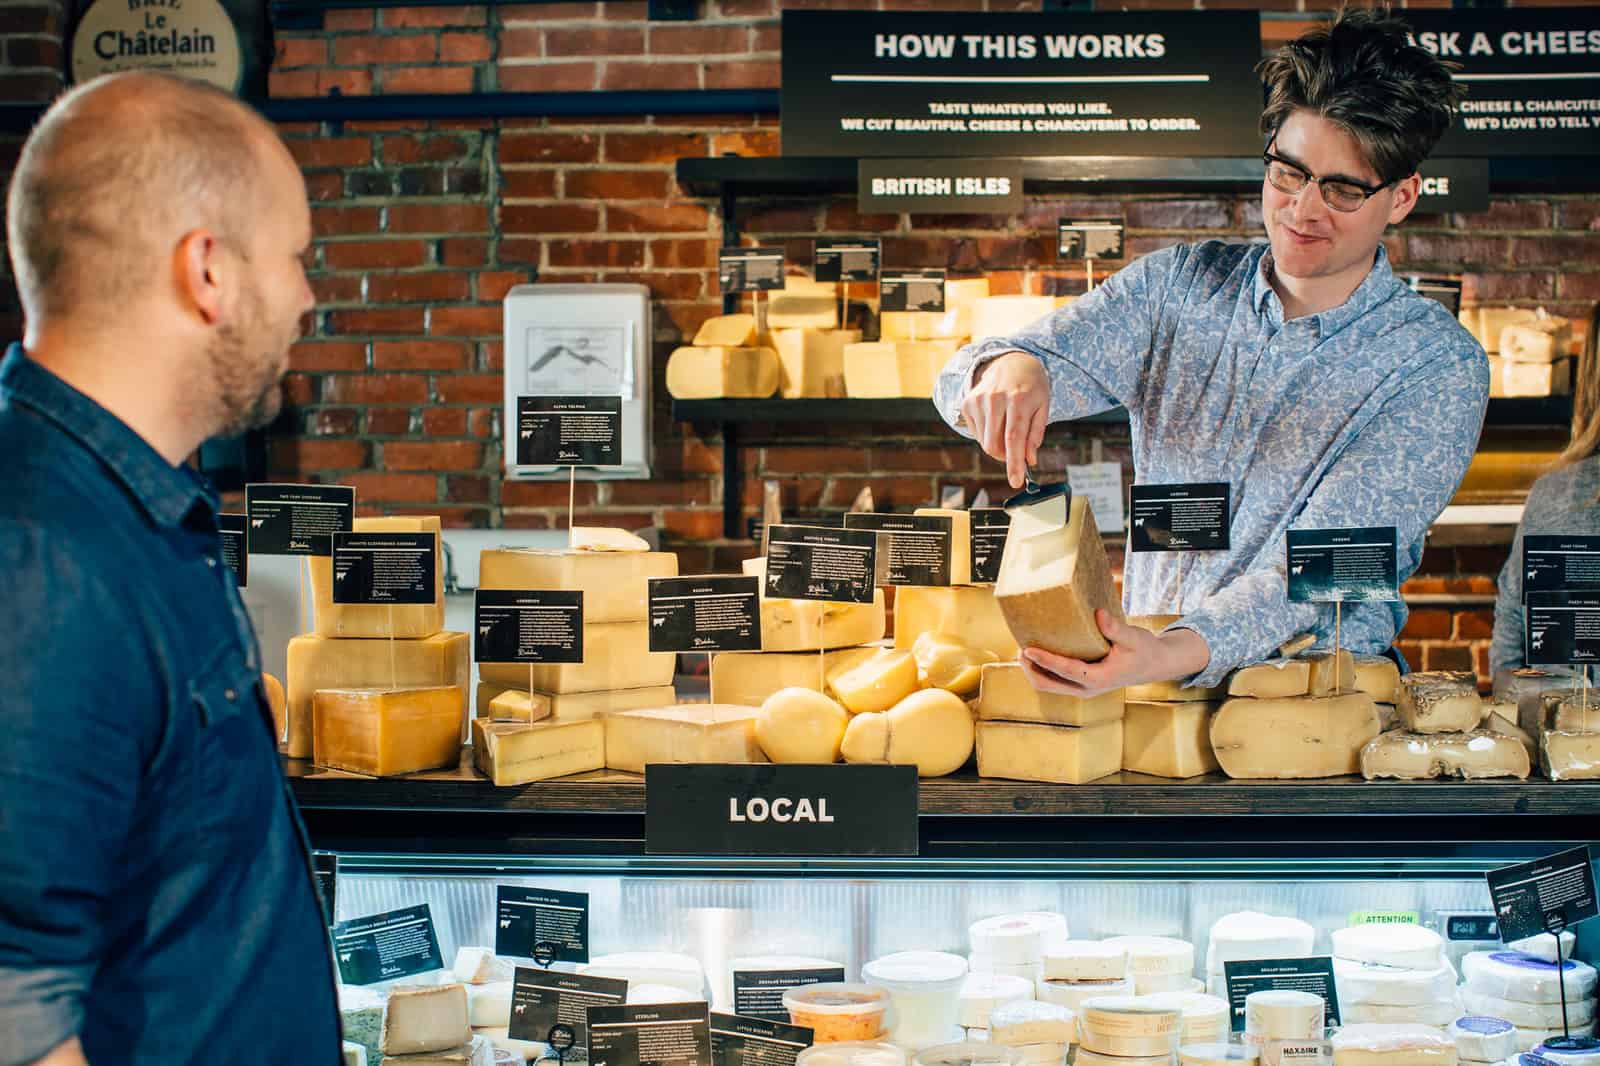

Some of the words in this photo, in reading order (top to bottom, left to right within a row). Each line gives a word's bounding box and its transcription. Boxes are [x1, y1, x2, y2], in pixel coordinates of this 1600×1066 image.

[144, 12, 167, 29] Le
[94, 28, 215, 60] Châtelain
[875, 33, 956, 58] HOW
[962, 34, 1038, 58] THIS
[1044, 33, 1166, 58] WORKS
[1469, 31, 1494, 56] A
[928, 102, 970, 115] TASTE
[970, 102, 1045, 115] WHATEVER
[1047, 102, 1076, 115] YOU
[1077, 102, 1113, 115] LIKE.
[1460, 100, 1511, 112] CHEESE
[1513, 100, 1524, 112] &
[841, 118, 865, 131] WE
[866, 118, 894, 131] CUT
[895, 118, 967, 131] BEAUTIFUL
[968, 118, 1021, 132] CHEESE
[1022, 119, 1034, 132] &
[1035, 118, 1129, 132] CHARCUTERIE
[1129, 118, 1149, 131] TO
[1149, 117, 1201, 131] ORDER.
[1463, 116, 1500, 129] WE'D
[1502, 116, 1537, 129] LOVE
[1538, 116, 1557, 128] TO
[1558, 116, 1590, 128] TELL
[871, 177, 951, 196] BRITISH
[955, 177, 1010, 196] ISLES
[729, 797, 835, 823] LOCAL
[1366, 915, 1413, 924] ATTENTION
